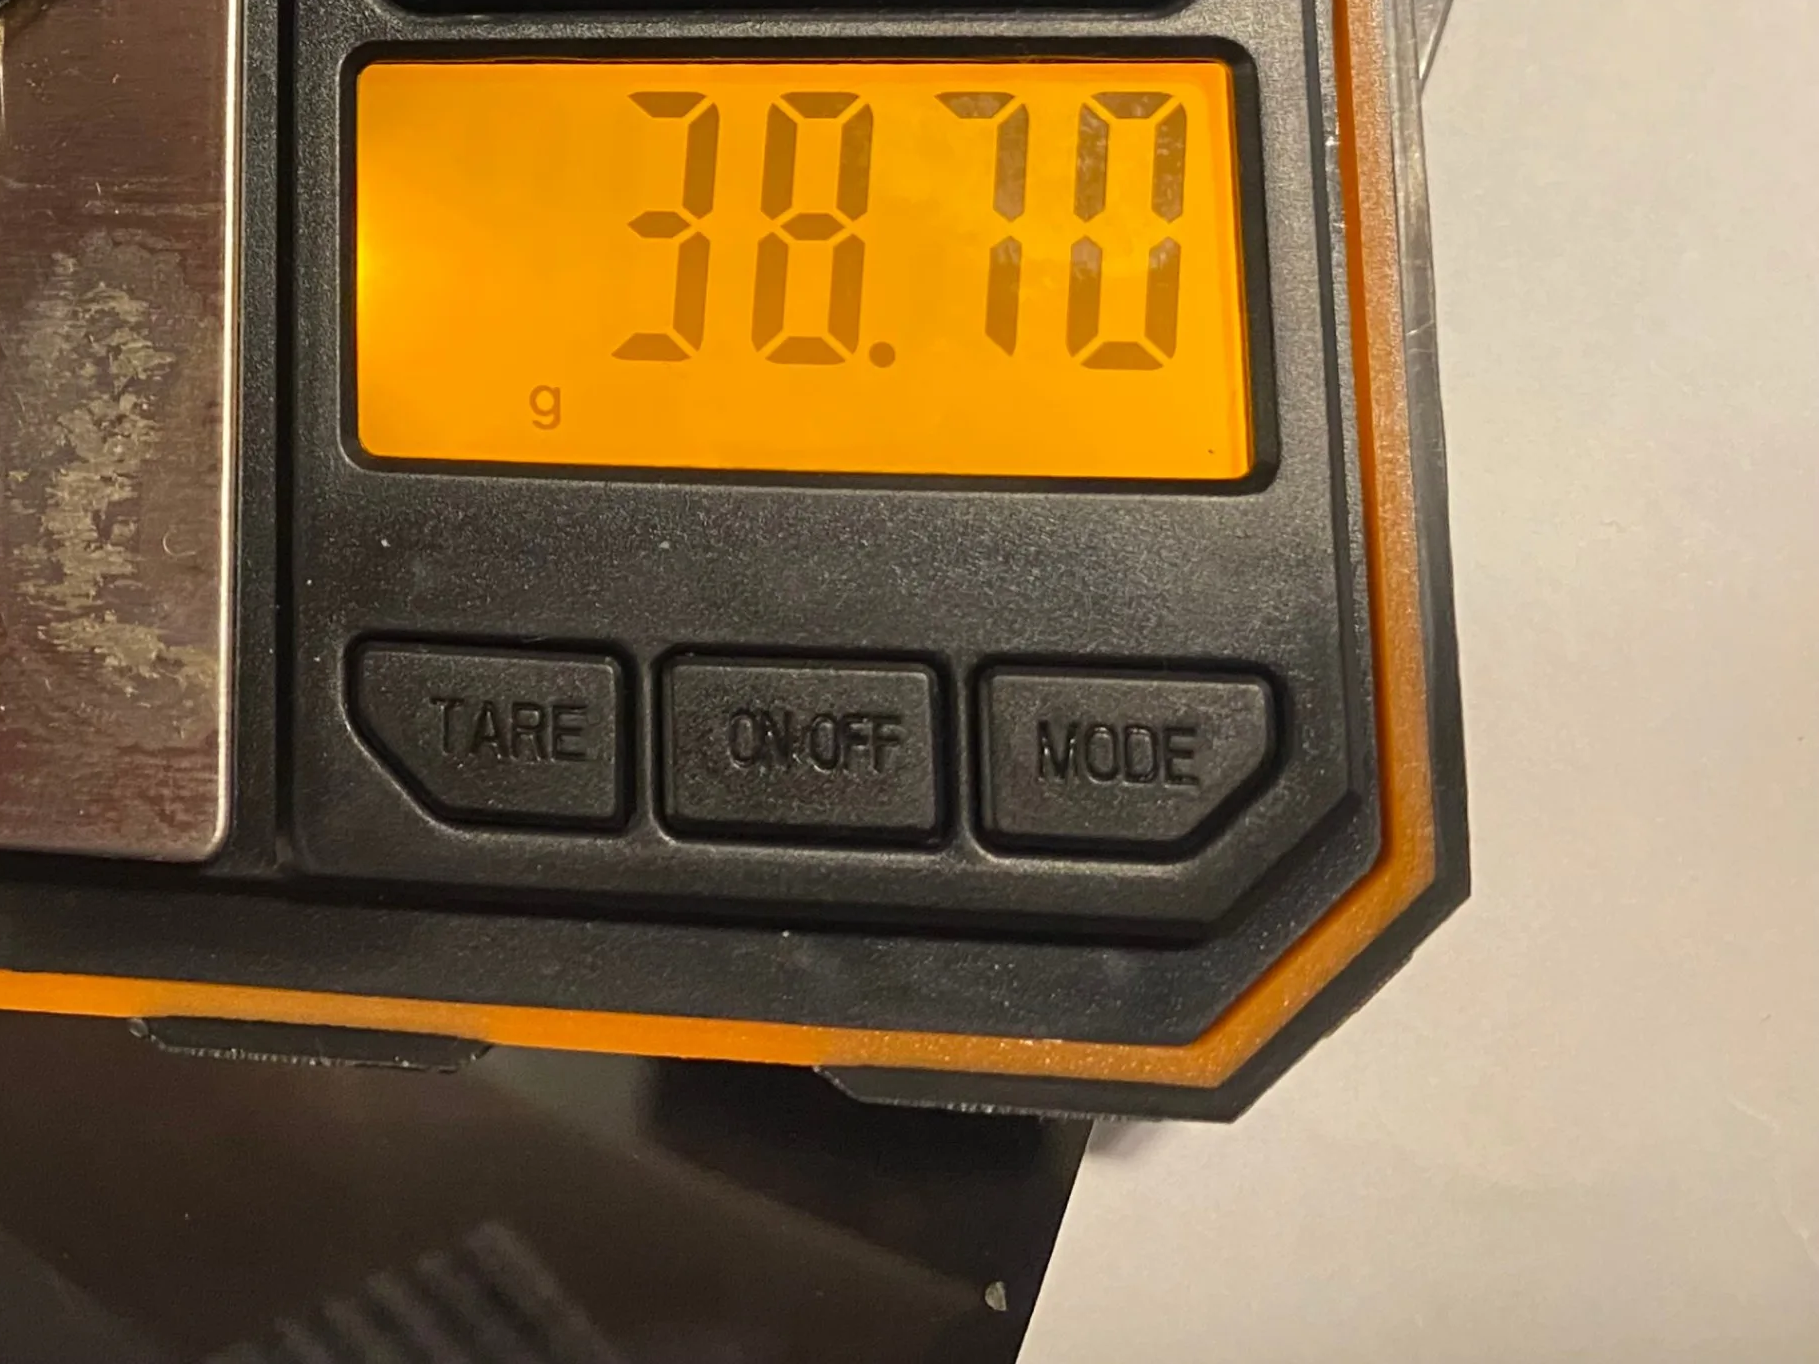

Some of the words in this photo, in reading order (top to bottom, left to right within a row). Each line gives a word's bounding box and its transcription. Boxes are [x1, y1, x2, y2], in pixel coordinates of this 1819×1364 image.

[611, 90, 1188, 371] 38.70
[527, 383, 563, 431] g
[429, 695, 590, 764] TARE
[1035, 717, 1201, 789] MODE
